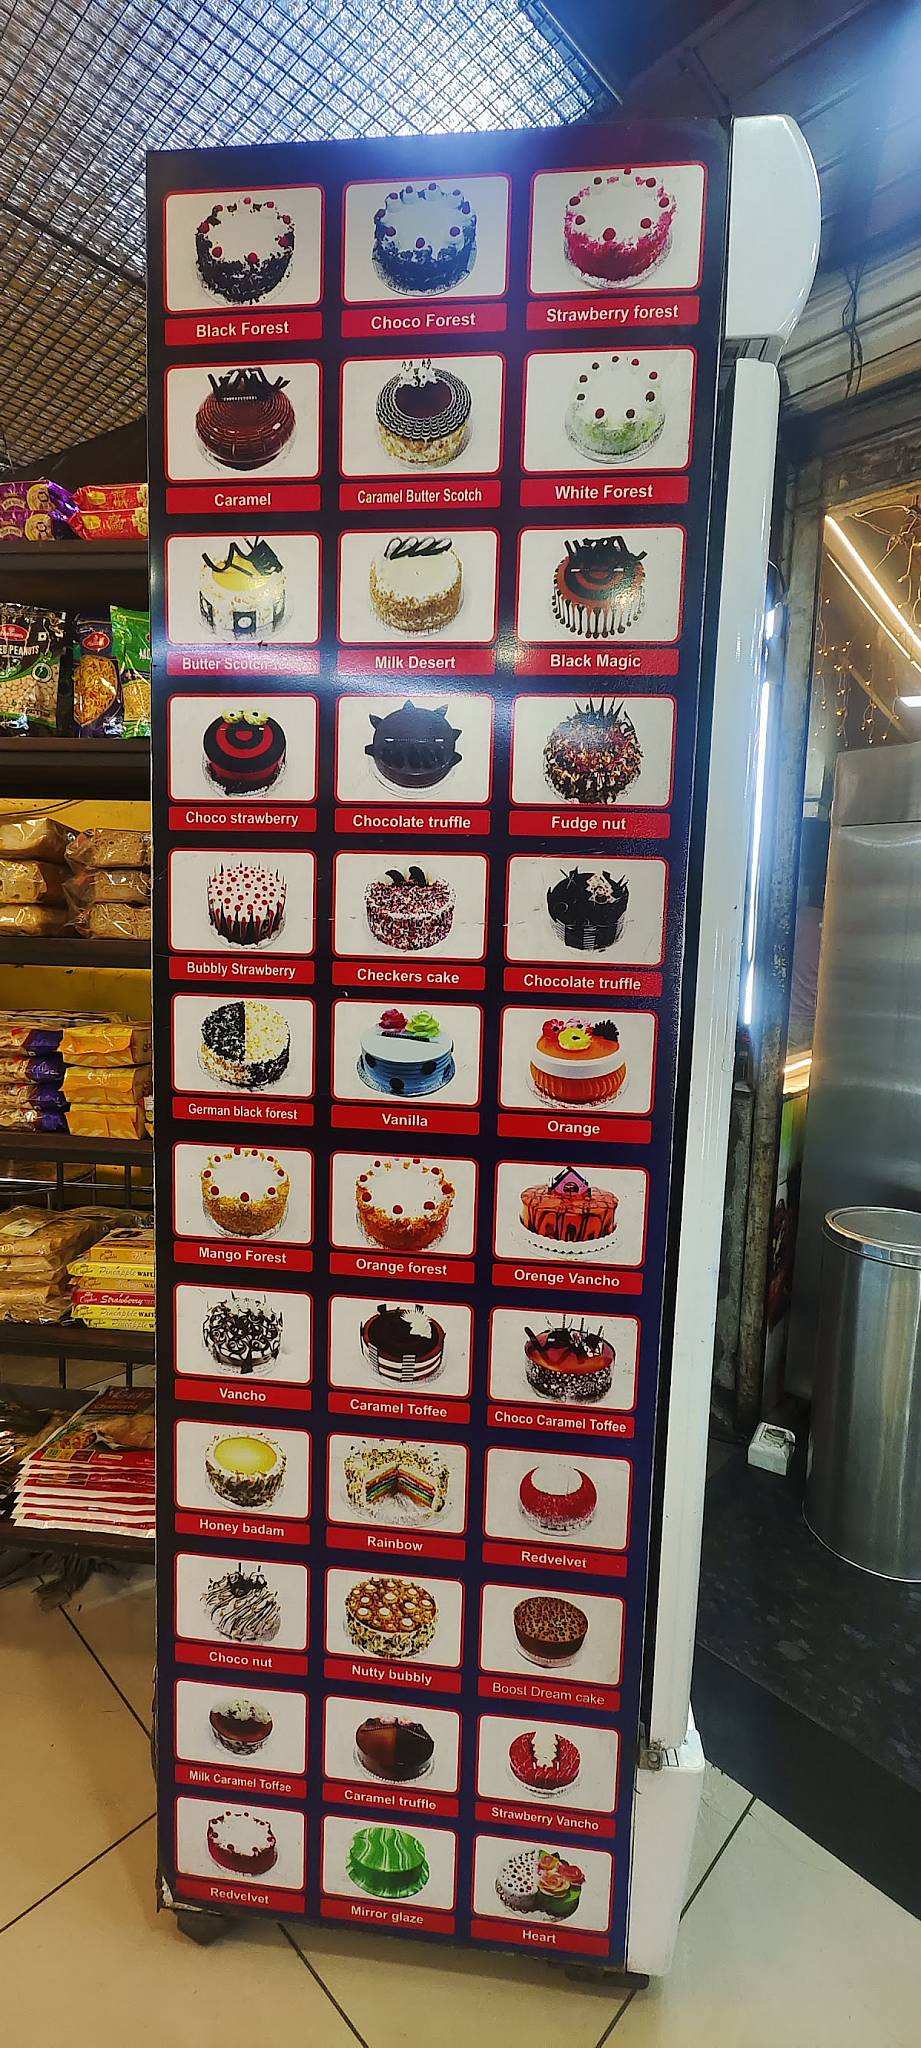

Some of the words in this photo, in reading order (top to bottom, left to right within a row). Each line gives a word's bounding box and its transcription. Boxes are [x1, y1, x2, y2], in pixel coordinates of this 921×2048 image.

[372, 316, 420, 329] Choco
[426, 313, 475, 327] Forest
[547, 307, 629, 322] Strawberry
[634, 305, 678, 318] forest
[197, 323, 236, 337] Black
[242, 321, 288, 335] Forest
[215, 493, 270, 506] Caramel
[358, 490, 402, 503] Caramel
[407, 490, 440, 502] Butter
[444, 488, 481, 501] Scotch
[555, 486, 598, 499] White
[604, 485, 652, 498] Forest
[9, 644, 40, 656] PEANUTS
[183, 658, 220, 669] Butter
[376, 656, 404, 669] Milk
[409, 656, 456, 669] Desert
[551, 654, 591, 666] Black
[597, 654, 640, 670] Magic
[186, 812, 226, 823] Choco
[231, 812, 298, 827] strawberry
[353, 815, 424, 827] Chocolate
[429, 816, 470, 828] truffle
[552, 816, 597, 832] Fudge
[603, 818, 626, 830] nut
[188, 962, 227, 976] Bubbly
[232, 963, 295, 979] Strawberry
[358, 969, 422, 982] Checkers
[427, 972, 459, 983] cake
[524, 974, 594, 988] Chocolate
[599, 978, 640, 990] truffle
[189, 1104, 230, 1115] German
[234, 1106, 262, 1117] black
[266, 1107, 297, 1119] forest
[382, 1114, 427, 1126] Vanilla
[548, 1121, 600, 1136] Orange
[200, 1247, 241, 1262] Mango
[246, 1250, 286, 1263] Forest
[356, 1259, 404, 1274] Orange
[408, 1262, 446, 1275] forest
[515, 1270, 564, 1285] Orenge
[569, 1273, 619, 1286] Vancho
[101, 1294, 143, 1305] Strawberry
[220, 1388, 266, 1401] Vancho
[350, 1399, 403, 1413] Caramel
[408, 1404, 447, 1417] Toffee
[495, 1411, 532, 1424] Choco
[537, 1415, 585, 1428] Caramel
[590, 1419, 626, 1432] Toffee
[200, 1519, 238, 1534] Honey
[243, 1523, 284, 1536] badam
[368, 1536, 422, 1550] Rainbow
[522, 1551, 586, 1568] Redvelvet
[210, 1652, 248, 1664] Choco
[253, 1658, 272, 1667] nut
[352, 1665, 385, 1680] Nutty
[389, 1670, 432, 1685] bubbly
[493, 1682, 527, 1695] Boost
[532, 1686, 572, 1700] Dream
[576, 1694, 605, 1705] cake
[190, 1770, 210, 1782] Milk
[214, 1774, 256, 1788] Caramel
[345, 1790, 395, 1805] Caramel
[400, 1799, 437, 1810] truffle
[492, 1807, 553, 1826] Strawberry
[557, 1815, 599, 1831] Vancho
[211, 1888, 268, 1904] Redvelvet
[352, 1906, 388, 1920] Mirror
[392, 1912, 424, 1924] glaze
[523, 1930, 555, 1943] Heart
